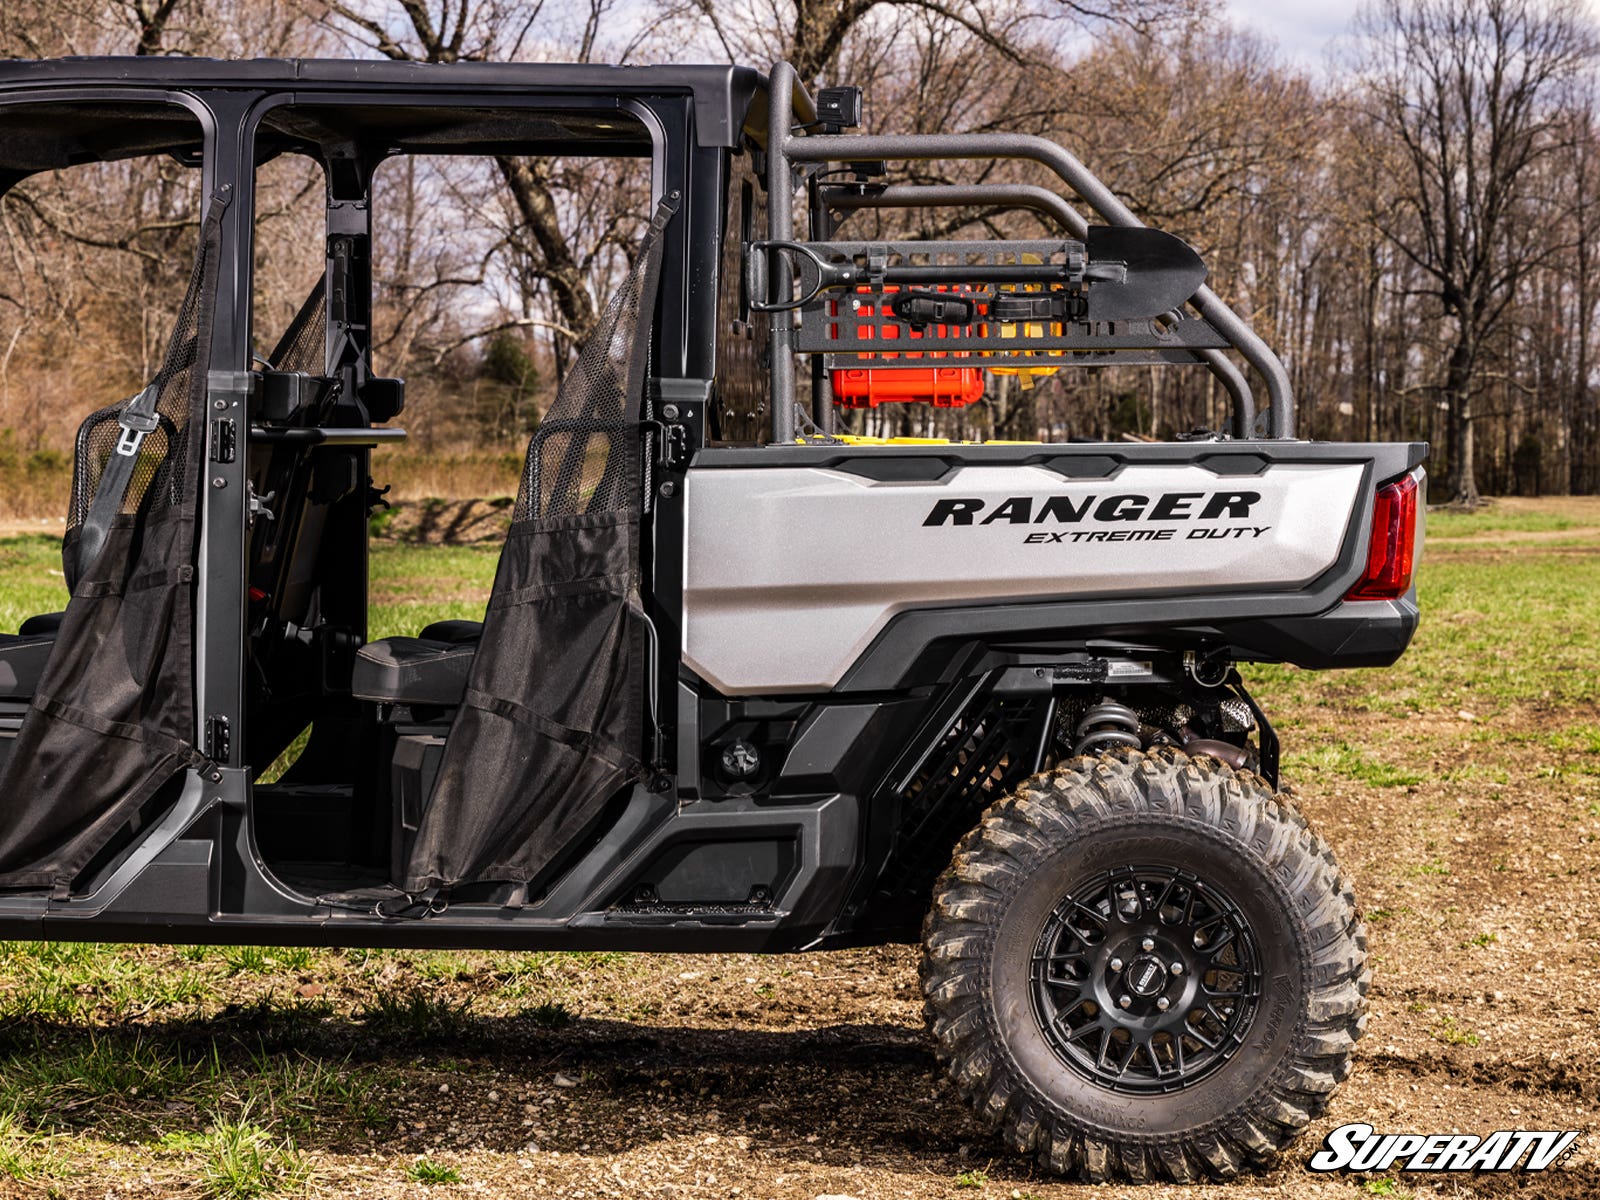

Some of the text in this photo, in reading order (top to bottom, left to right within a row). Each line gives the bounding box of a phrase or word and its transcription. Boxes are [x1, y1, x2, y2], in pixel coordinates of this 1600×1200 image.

[922, 491, 1261, 526] RANGER
[1023, 526, 1272, 544] EXTREME DUTY
